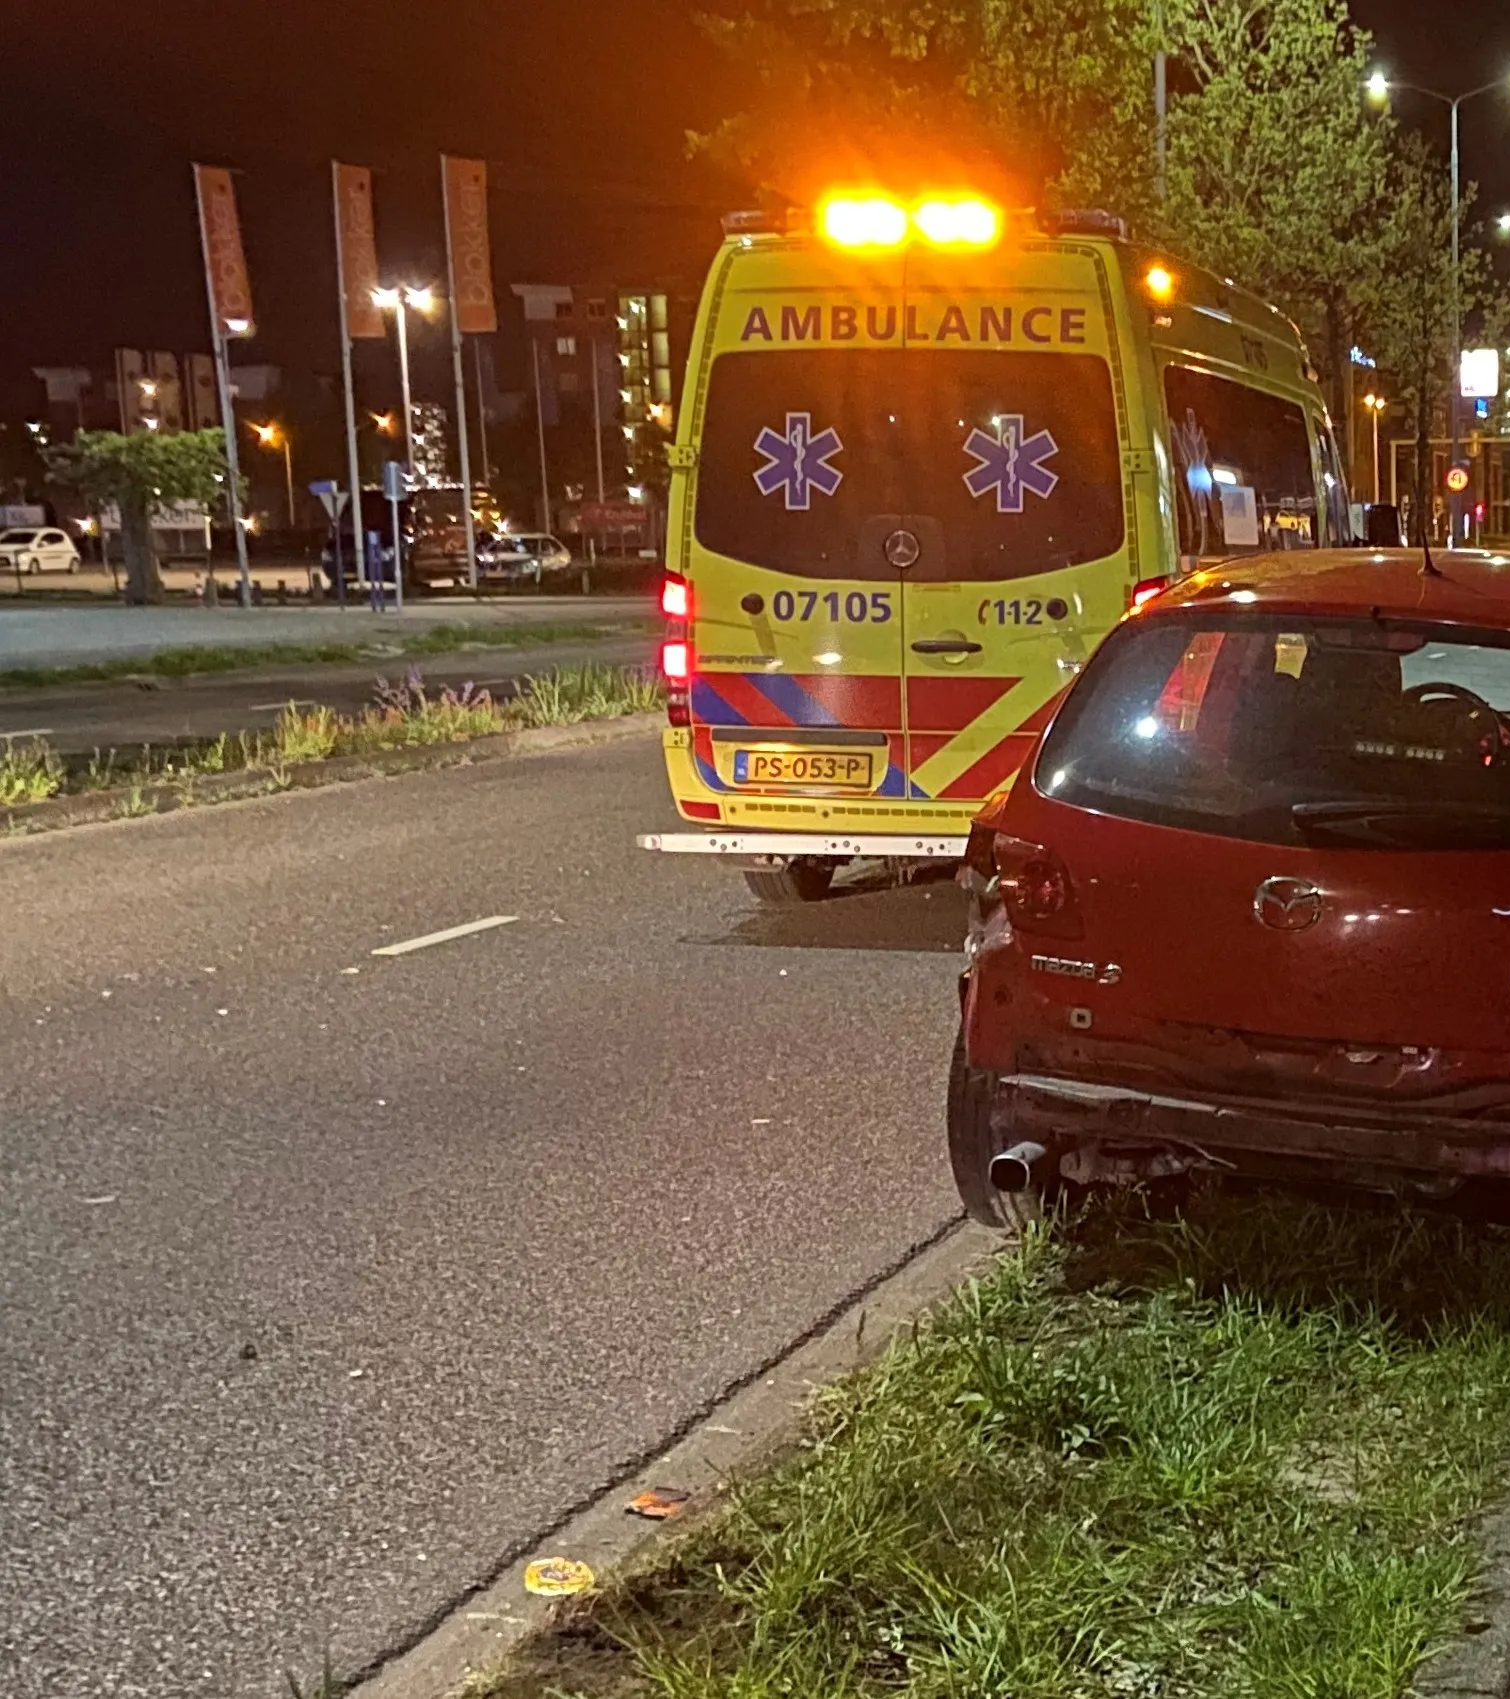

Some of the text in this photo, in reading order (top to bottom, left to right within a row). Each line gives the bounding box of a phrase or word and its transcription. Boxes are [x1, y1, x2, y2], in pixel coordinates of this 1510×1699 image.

[740, 305, 1086, 344] AMBULANCE
[773, 590, 892, 623] 07105
[754, 756, 861, 780] PS-053-P
